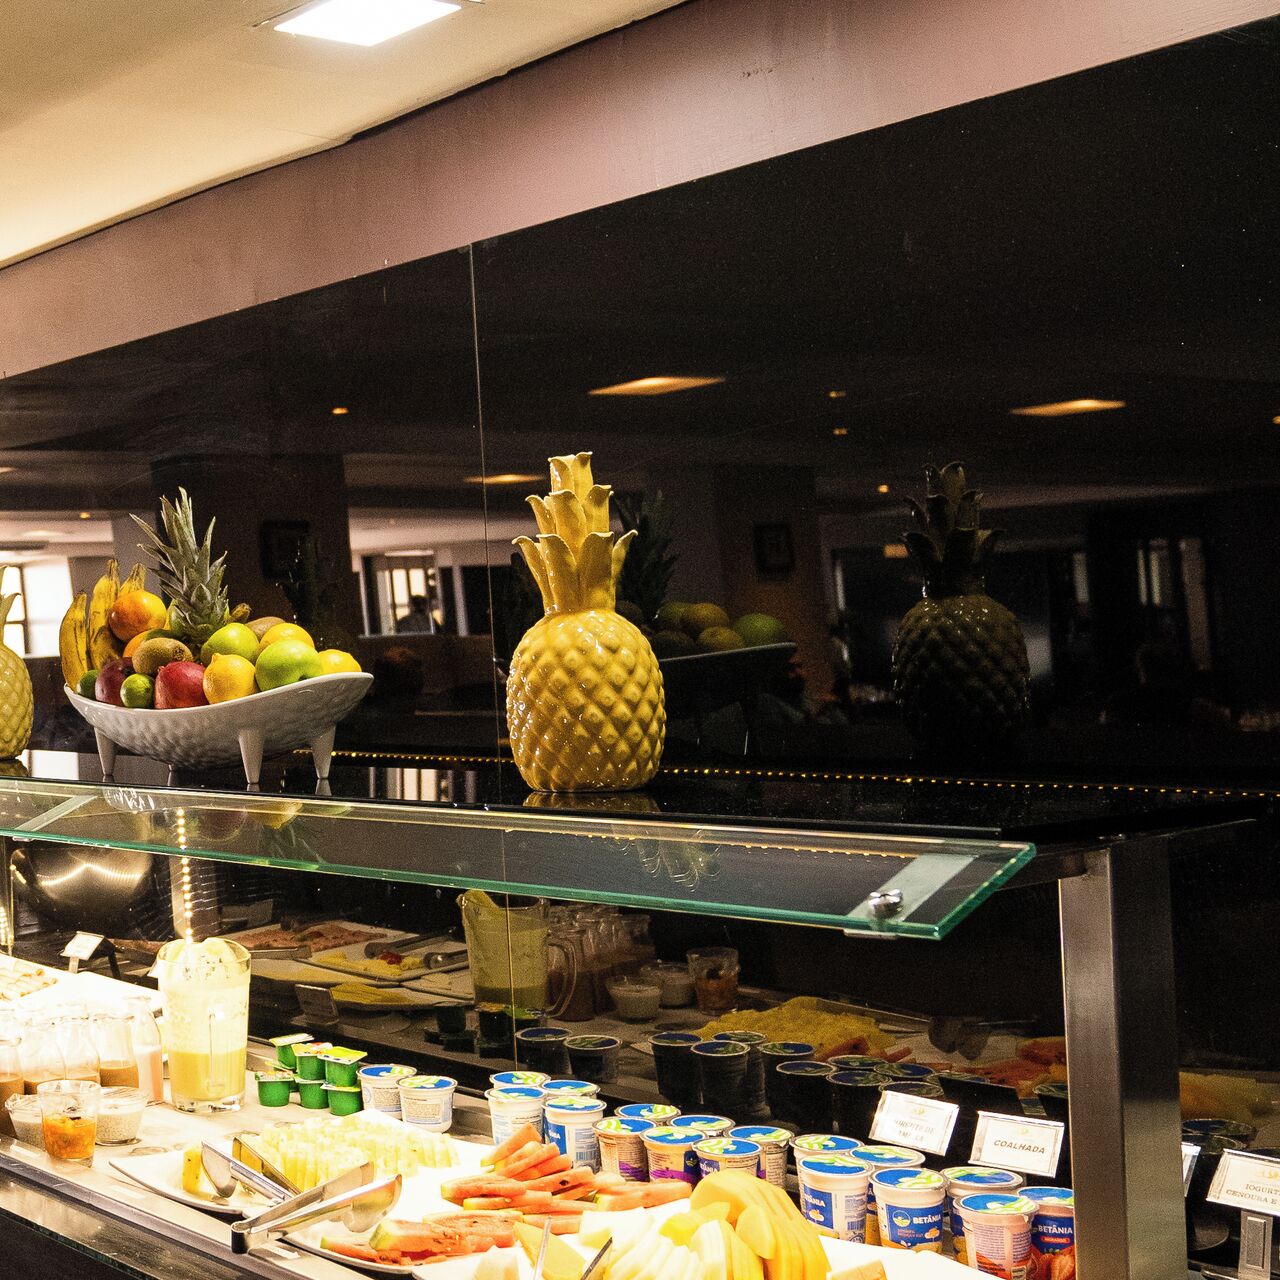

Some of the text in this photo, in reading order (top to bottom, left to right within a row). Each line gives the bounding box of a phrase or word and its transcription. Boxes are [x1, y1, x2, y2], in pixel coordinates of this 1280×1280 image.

[993, 1139, 1046, 1154] COALHADA
[1245, 1183, 1280, 1195] IOGURT
[1038, 1223, 1073, 1234] BETÂNIA
